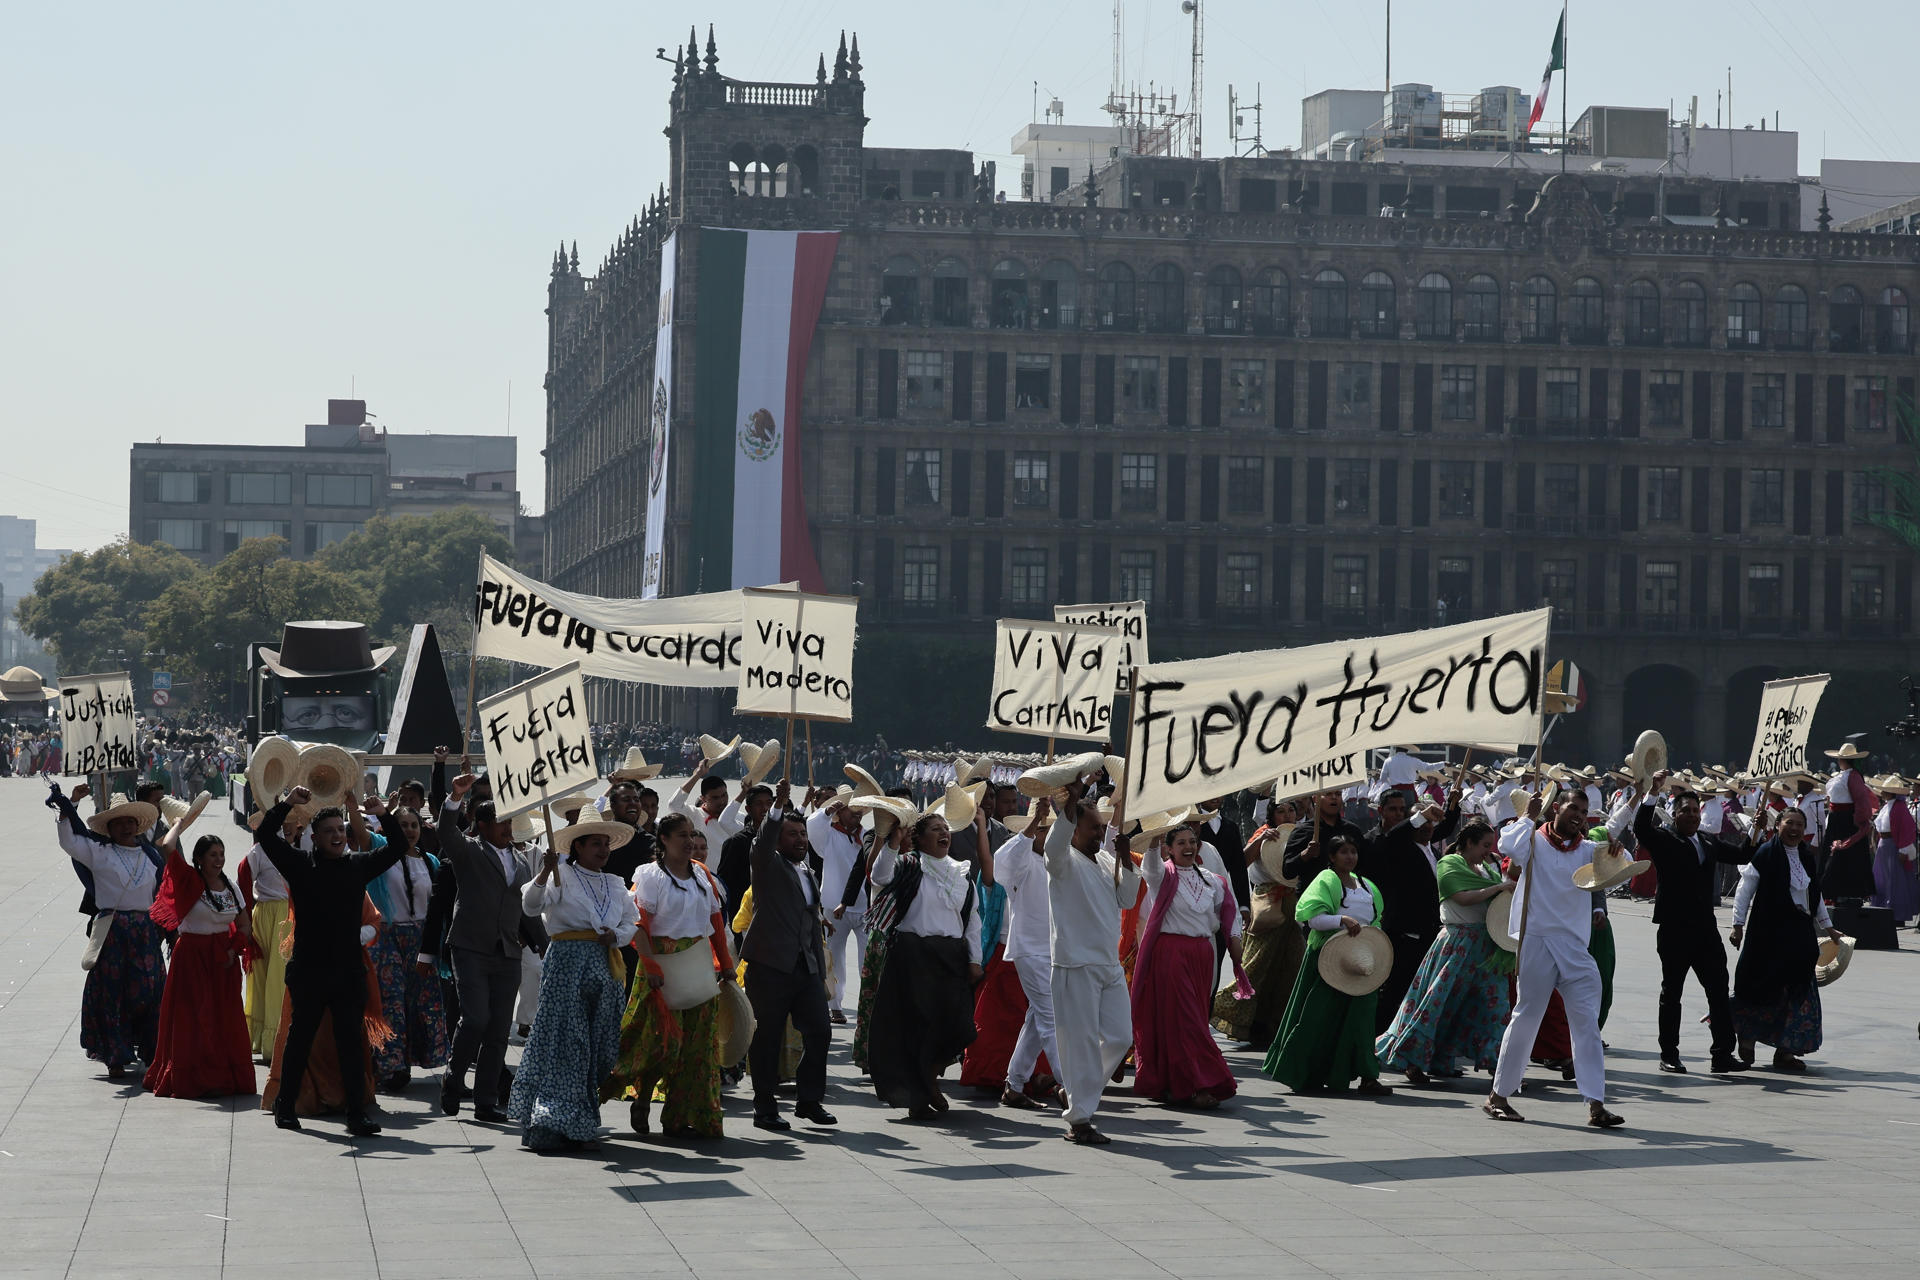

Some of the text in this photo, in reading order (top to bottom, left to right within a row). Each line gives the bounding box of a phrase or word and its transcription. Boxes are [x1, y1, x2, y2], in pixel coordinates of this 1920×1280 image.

[747, 663, 851, 702] Madero
[1135, 633, 1541, 796] Fuera Huerta
[497, 734, 590, 806] Huerta
